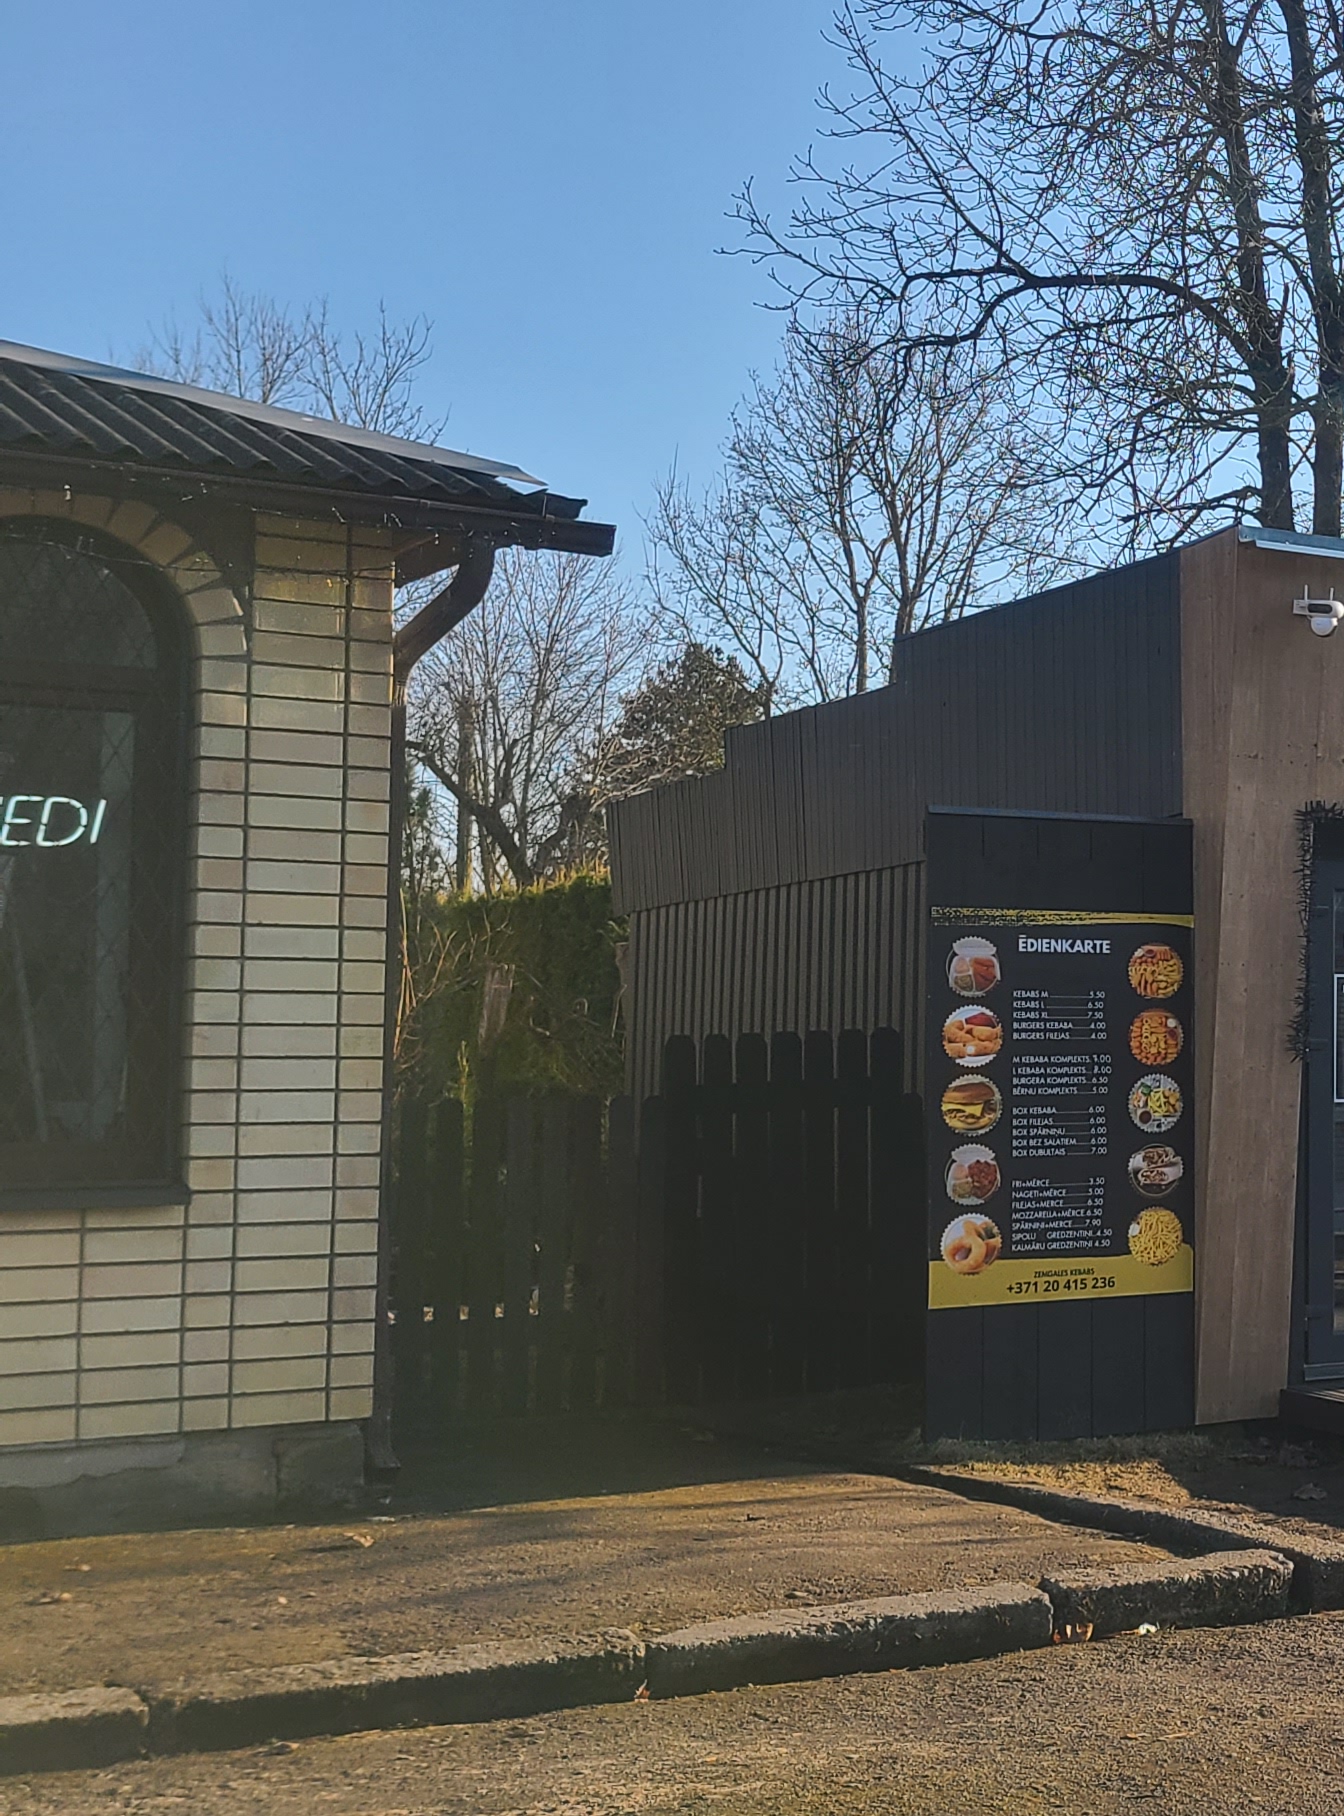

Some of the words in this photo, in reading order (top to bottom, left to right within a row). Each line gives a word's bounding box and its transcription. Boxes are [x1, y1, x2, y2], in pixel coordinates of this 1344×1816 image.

[0, 796, 107, 846] EDI
[1019, 935, 1111, 953] ĒDIENKARTE
[1029, 1148, 1065, 1156] DUBULTAIS
[1034, 1270, 1068, 1278] ZEMGALES
[1070, 1268, 1094, 1276] KEBABS
[1007, 1282, 1038, 1294] +371
[1043, 1280, 1059, 1292] 20
[1063, 1279, 1087, 1291] 415
[1092, 1277, 1115, 1289] 236
